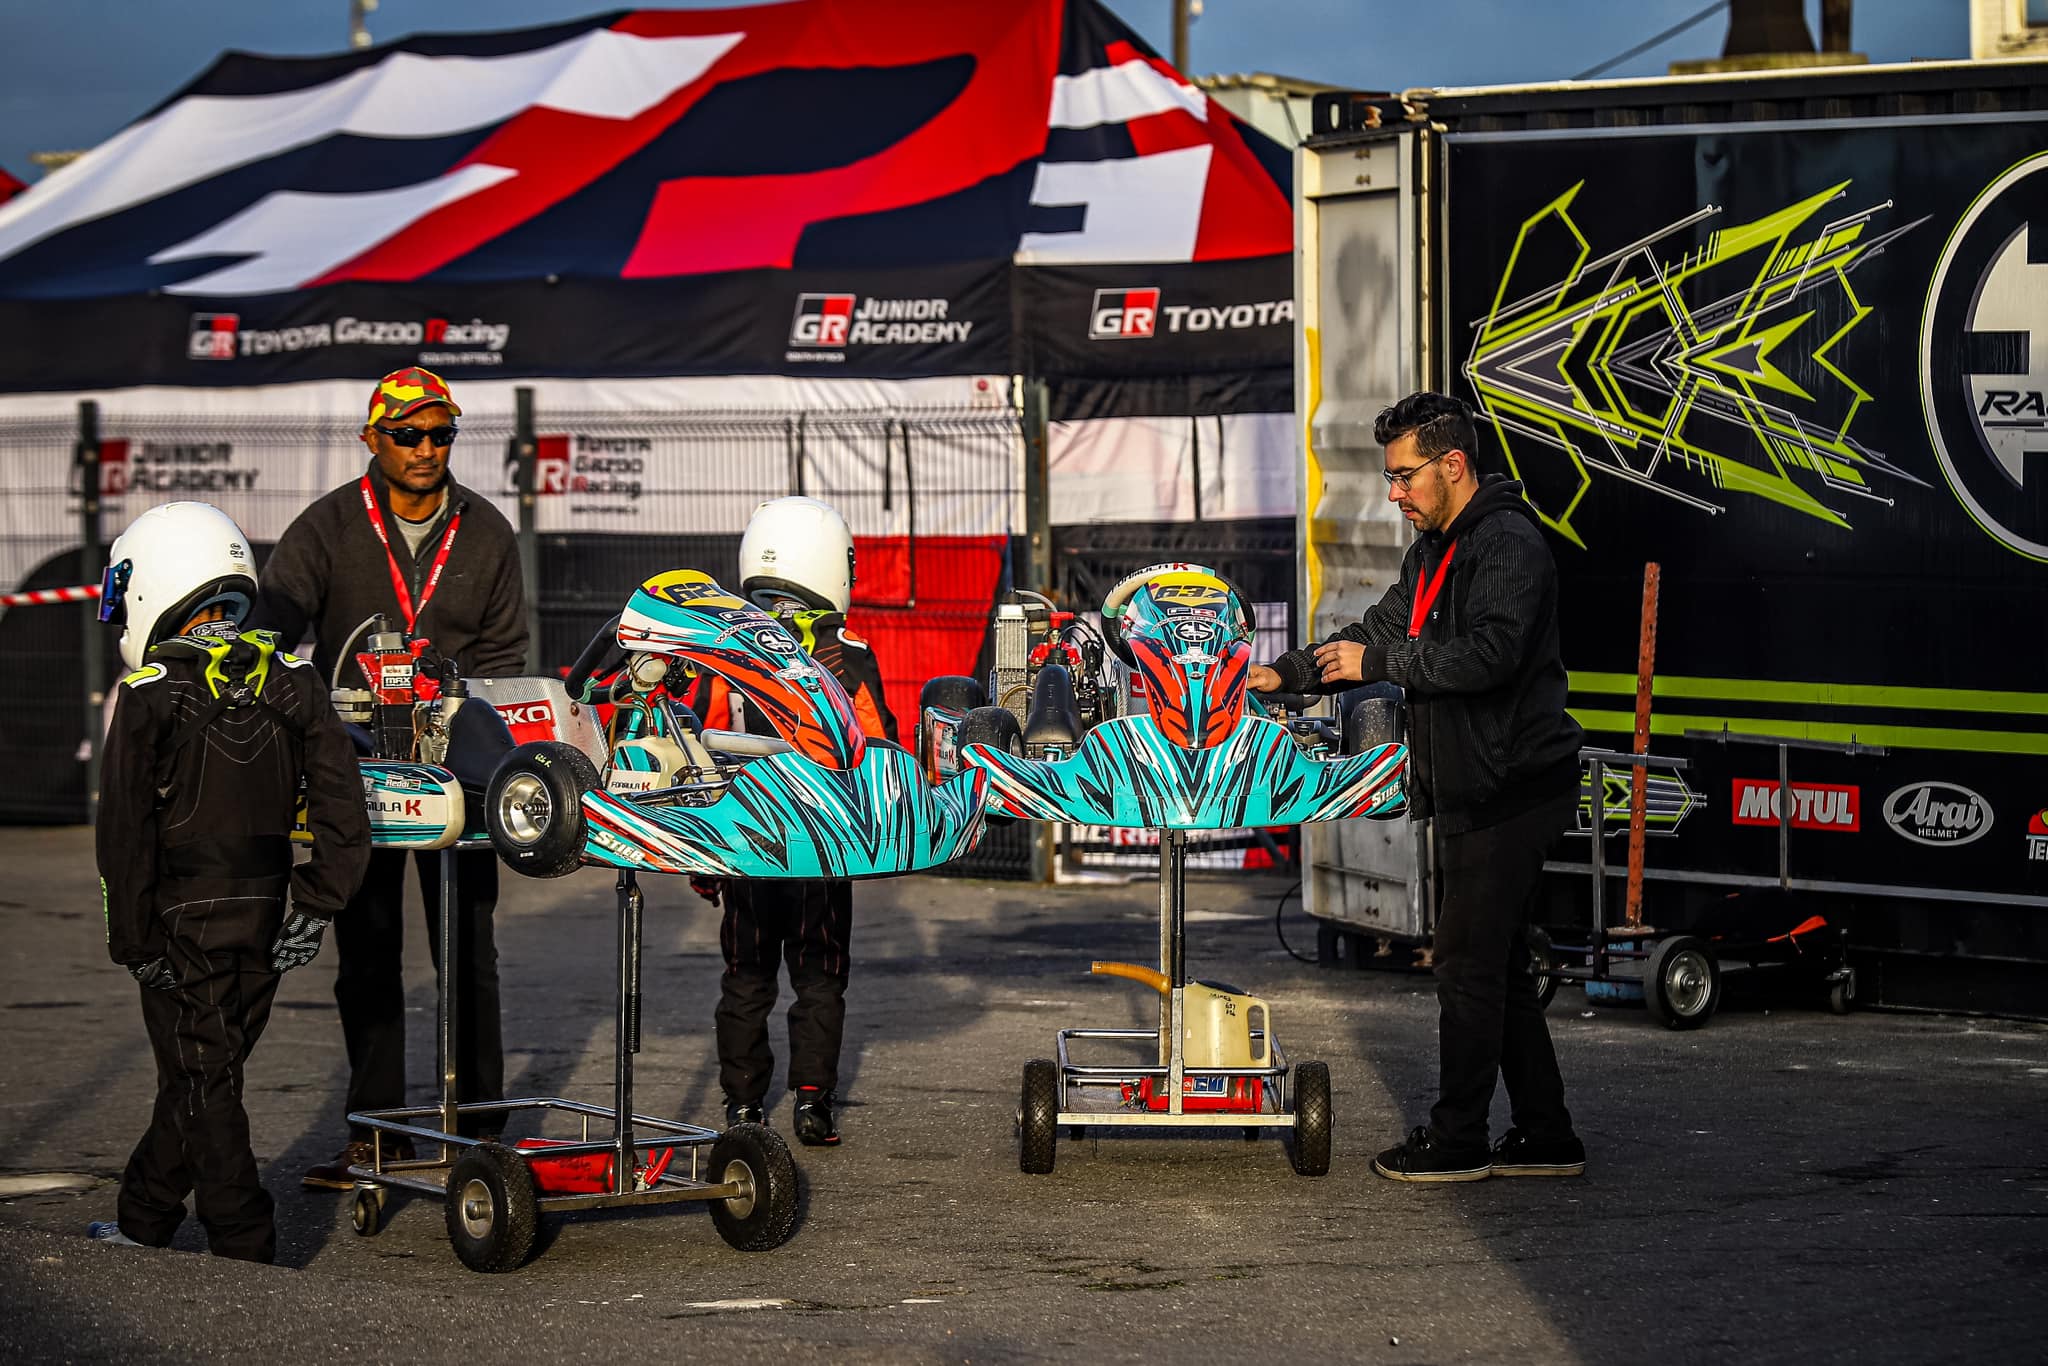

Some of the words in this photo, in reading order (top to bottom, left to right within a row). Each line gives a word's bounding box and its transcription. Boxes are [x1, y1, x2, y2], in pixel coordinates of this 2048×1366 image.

[854, 298, 949, 321] JUNIOR
[1095, 306, 1154, 334] GR
[1163, 299, 1294, 333] TOYOTA
[424, 318, 510, 351] Racing
[793, 313, 849, 341] GR
[849, 321, 972, 345] ACADEMY
[1979, 390, 2048, 417] RA
[641, 782, 651, 791] K
[405, 799, 422, 817] K
[1739, 785, 1853, 824] MOTUL
[1890, 786, 1981, 831] Arai
[1918, 828, 1959, 839] HELMET
